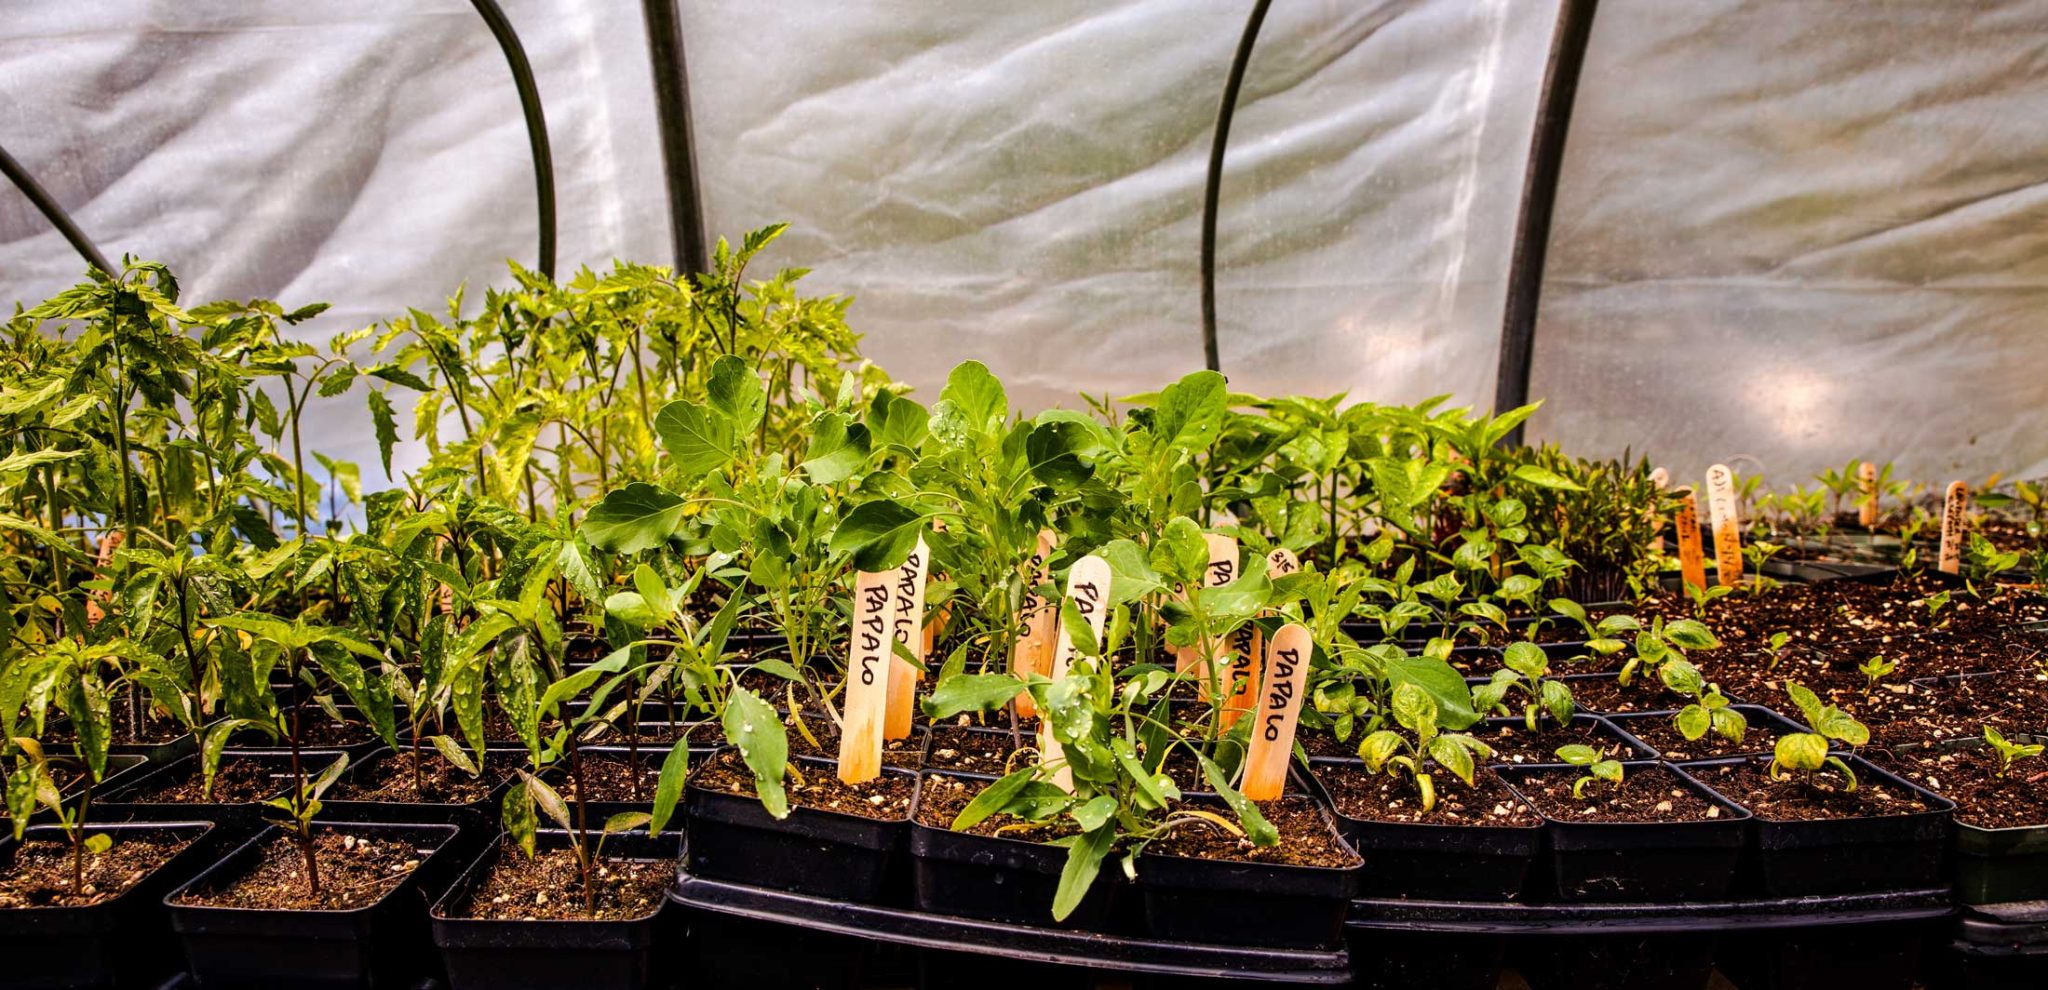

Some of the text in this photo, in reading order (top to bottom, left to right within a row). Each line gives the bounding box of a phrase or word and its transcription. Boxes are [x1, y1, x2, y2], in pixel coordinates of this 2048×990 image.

[1271, 551, 1295, 573] 3/5
[861, 584, 889, 685] PAPALO
[1264, 648, 1299, 742] PAPALO
